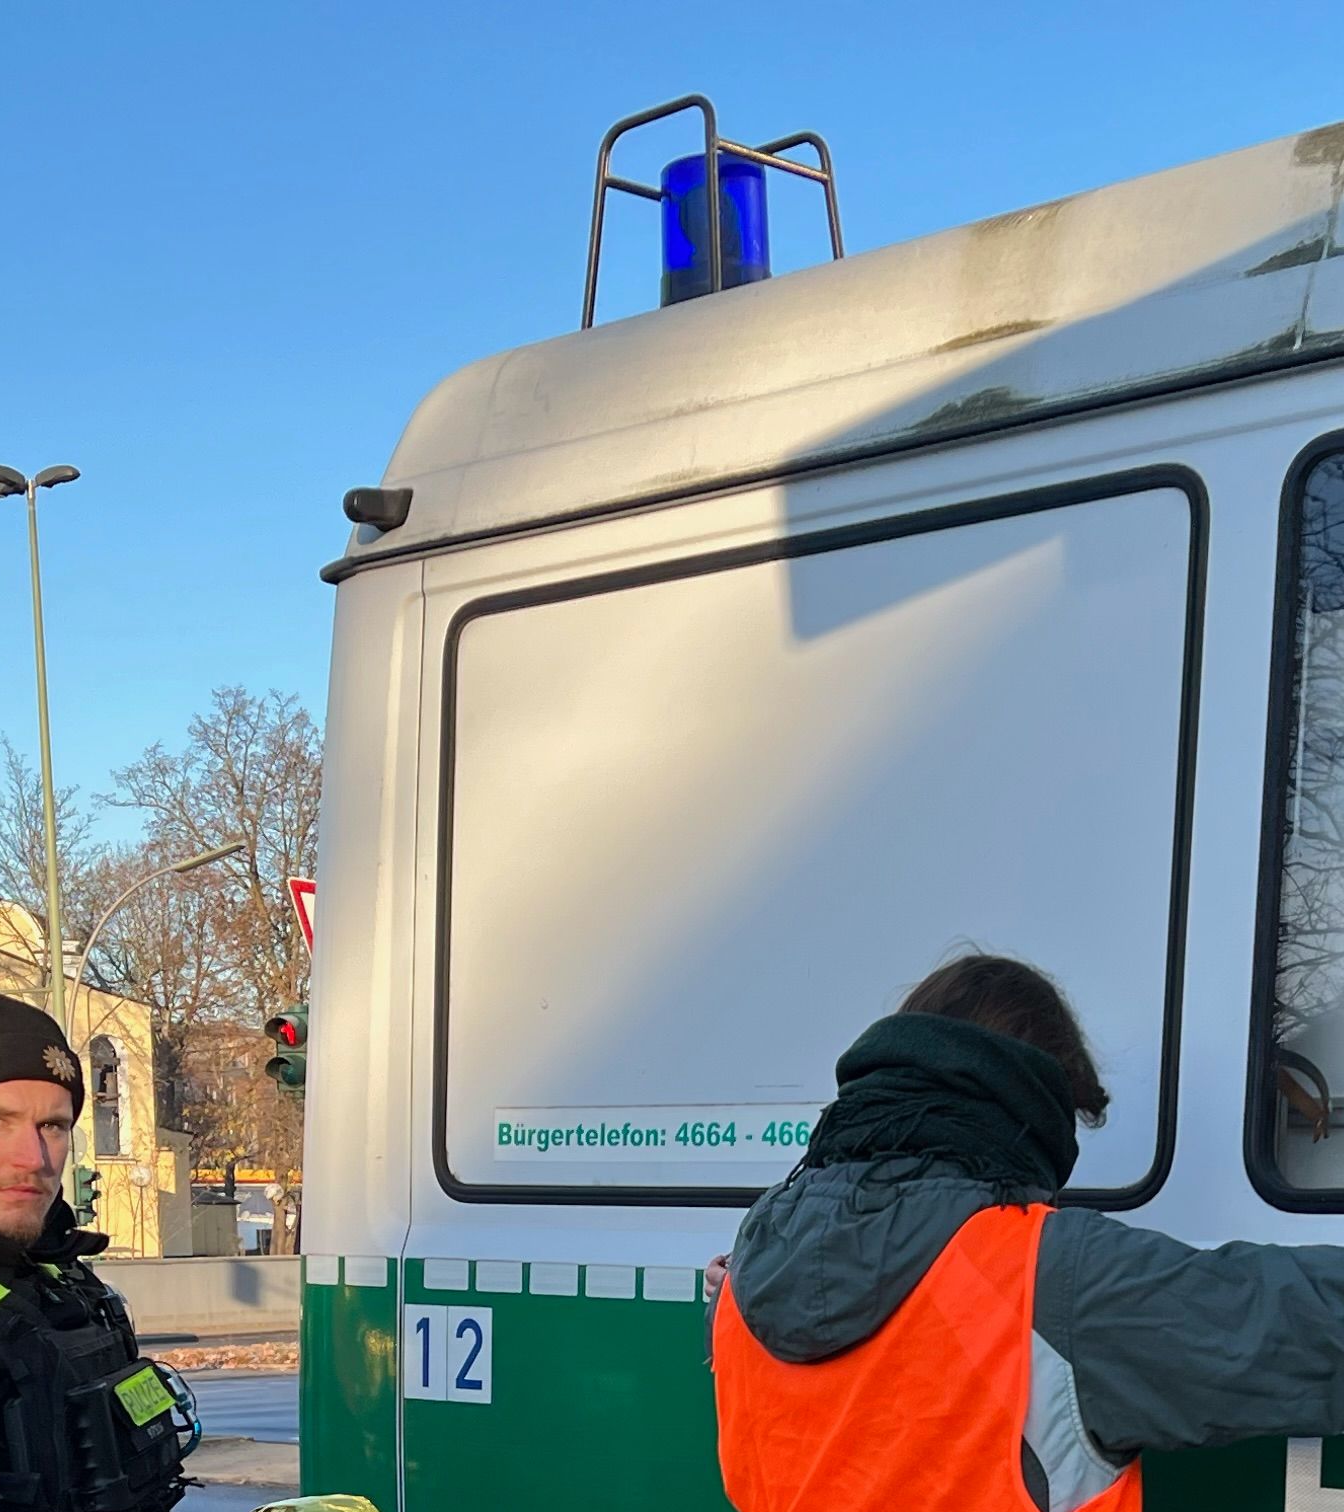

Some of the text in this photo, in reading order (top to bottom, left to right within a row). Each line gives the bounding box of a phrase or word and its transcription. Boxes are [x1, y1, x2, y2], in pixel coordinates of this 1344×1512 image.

[497, 1121, 667, 1153] Bürgertelefon:
[674, 1120, 738, 1147] 4664
[415, 1316, 484, 1391] 12
